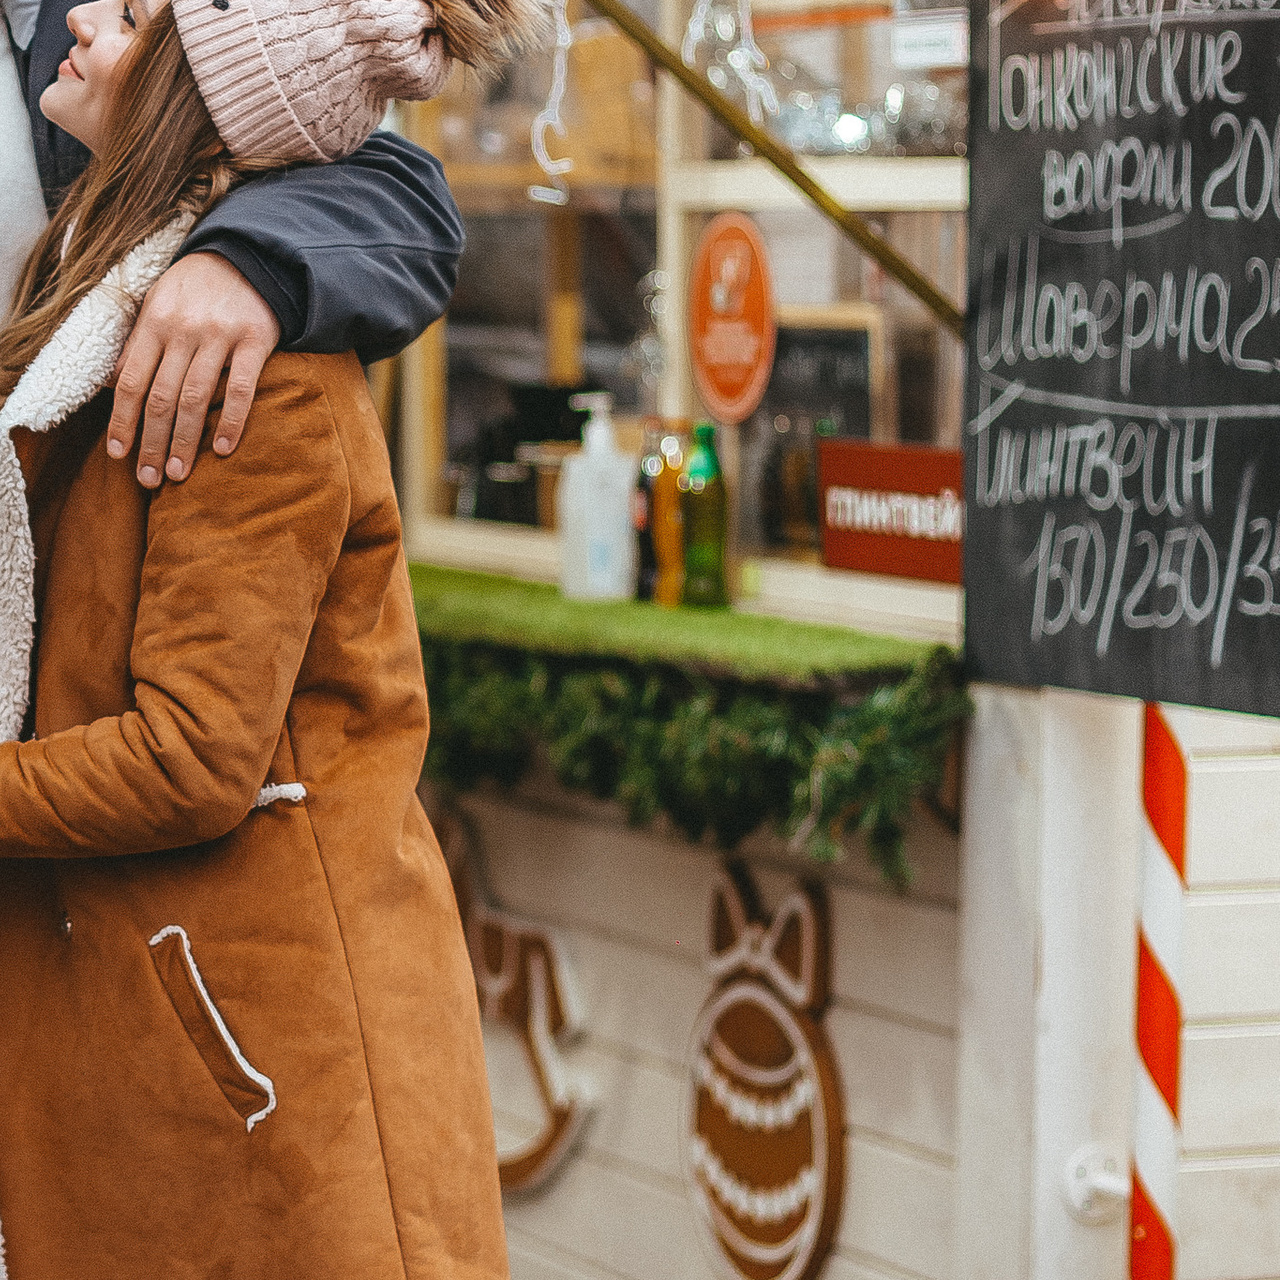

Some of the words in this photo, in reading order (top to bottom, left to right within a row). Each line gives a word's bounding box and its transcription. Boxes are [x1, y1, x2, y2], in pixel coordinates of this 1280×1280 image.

[1041, 136, 1192, 249] вафли
[1202, 111, 1280, 221] 20
[977, 232, 1231, 395] Шаверма
